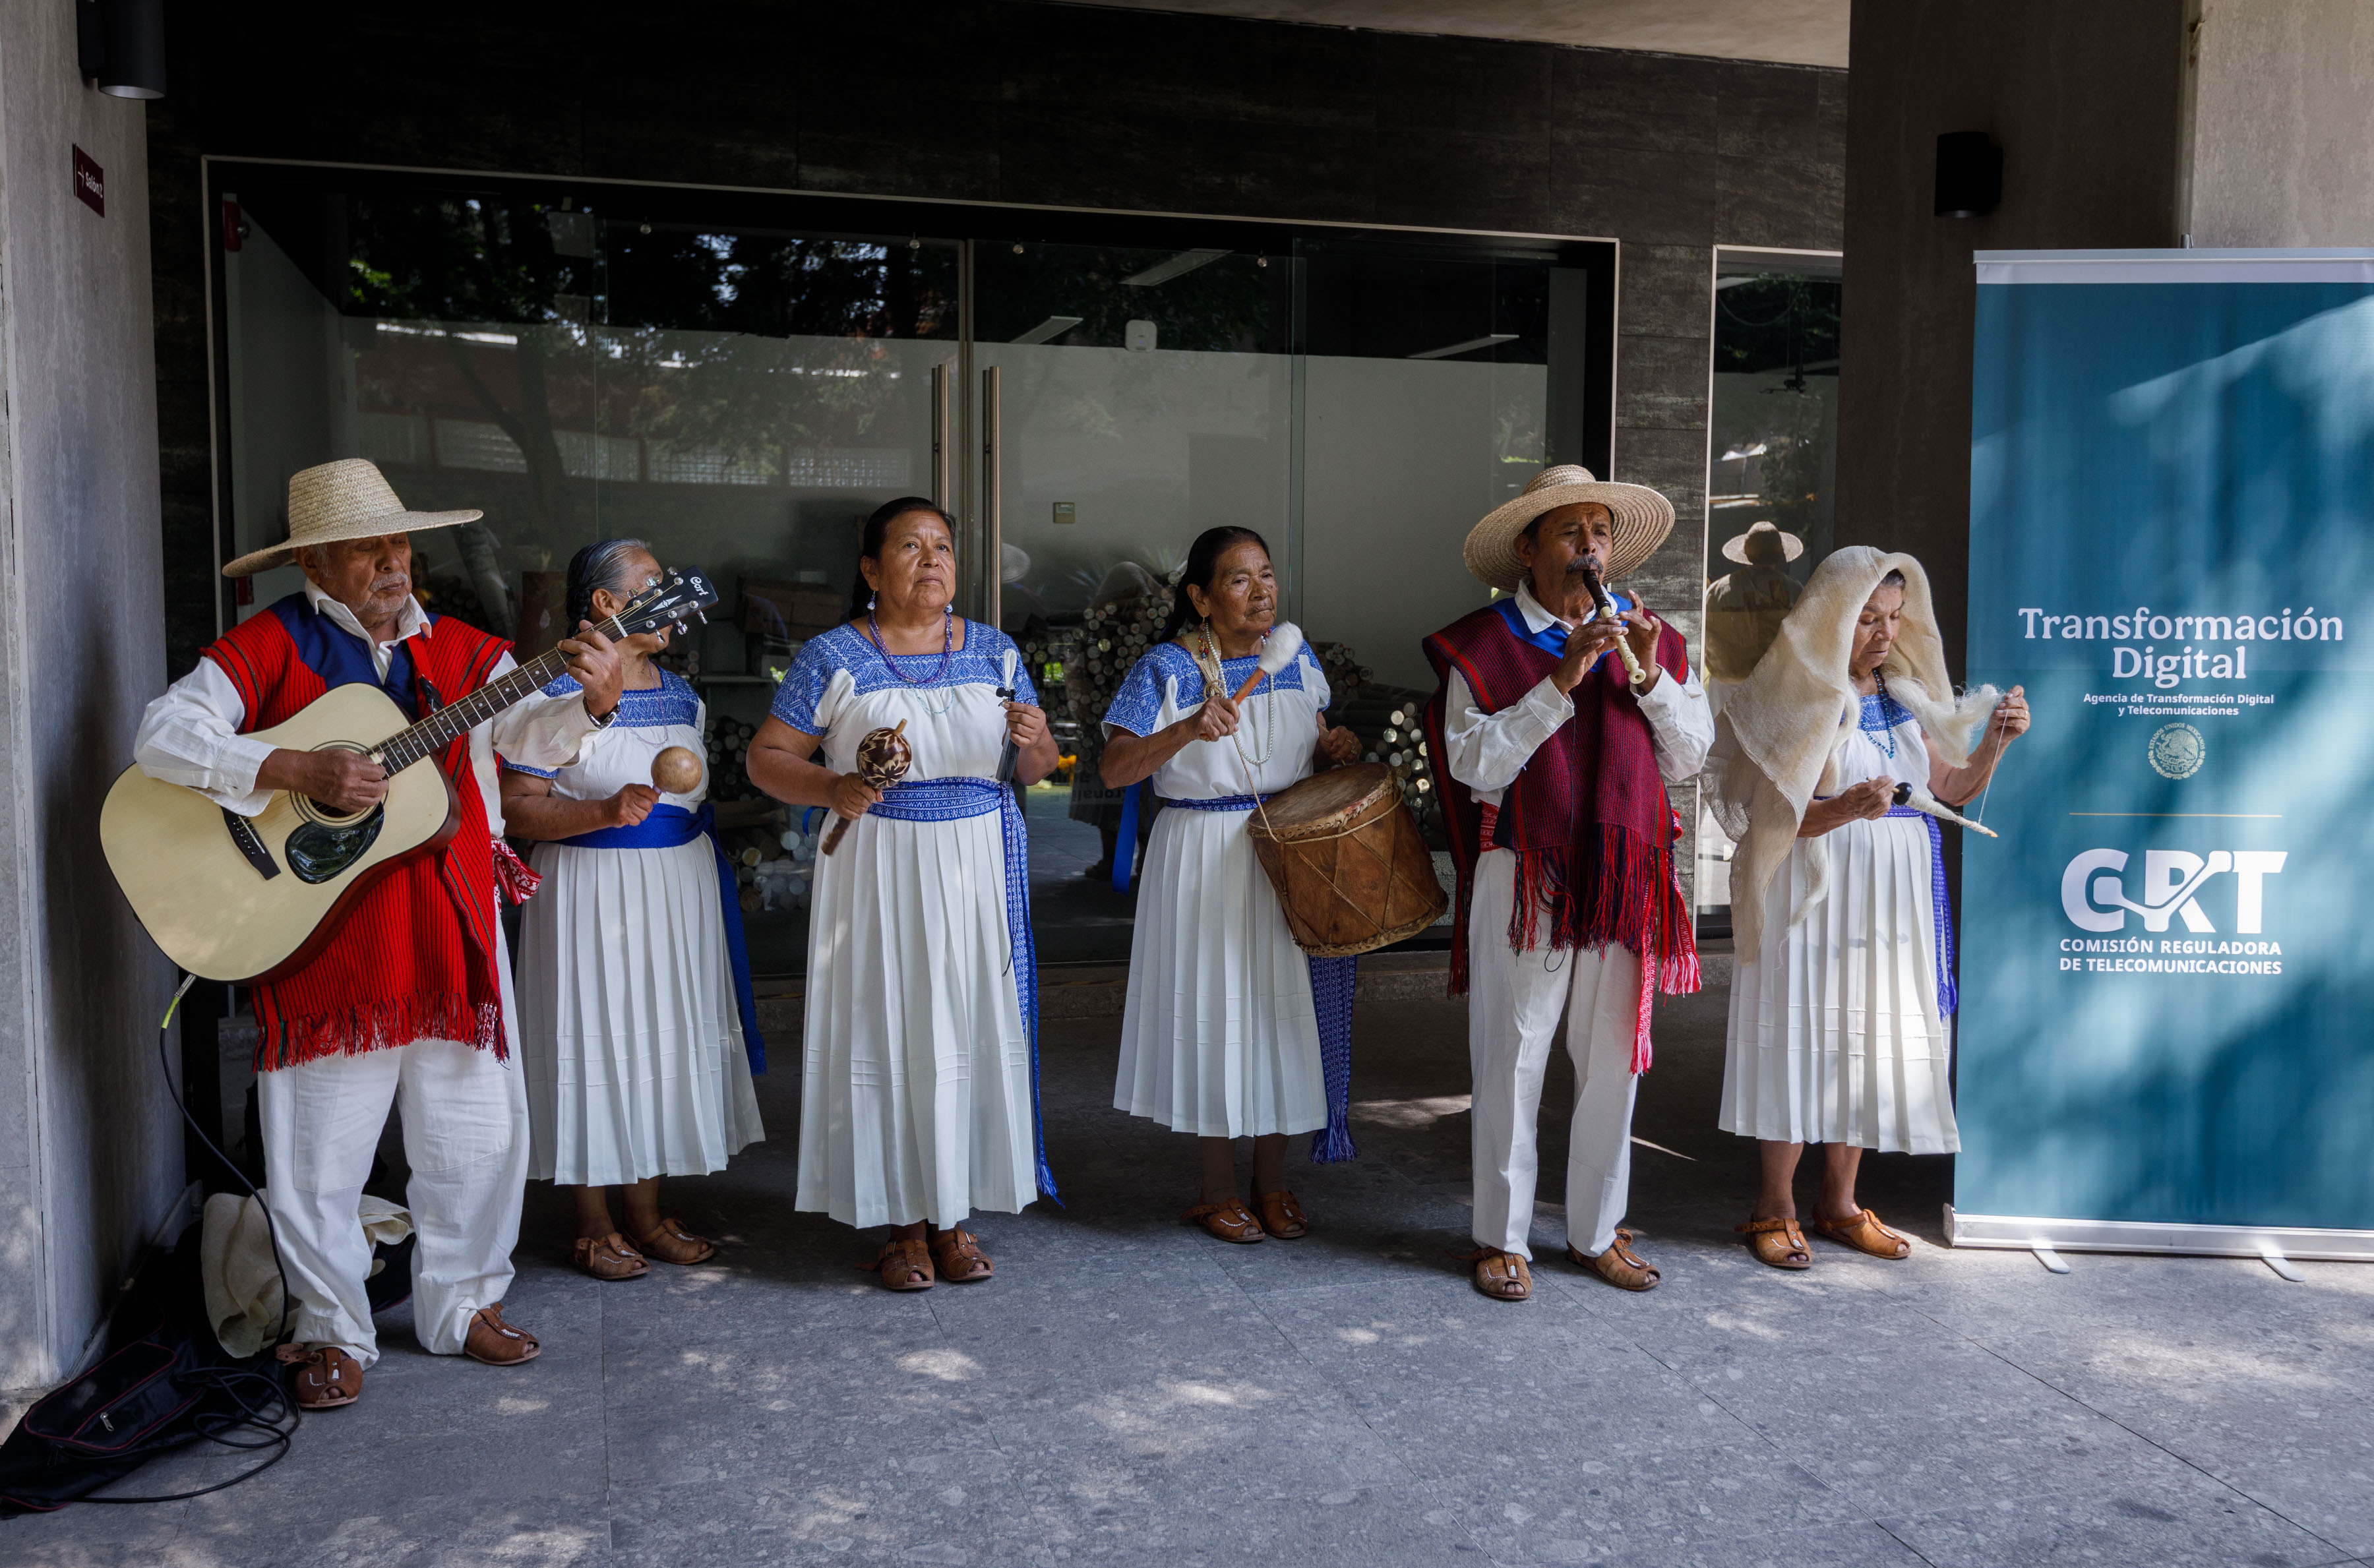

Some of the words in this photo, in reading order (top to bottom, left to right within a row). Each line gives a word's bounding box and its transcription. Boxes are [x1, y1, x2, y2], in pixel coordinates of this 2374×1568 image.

[85, 171, 100, 196] Salón
[690, 576, 710, 596] Cort
[2018, 606, 2344, 641] Transformación
[2112, 645, 2247, 689] Digital
[2083, 693, 2128, 705] Agencia
[2130, 693, 2144, 703] de
[2146, 694, 2234, 704] Transformación
[2237, 694, 2274, 706] Digital
[2117, 708, 2125, 717] y
[2127, 705, 2239, 715] Telecomunicaciones
[2148, 728, 2164, 749] ESTADOS
[2164, 722, 2185, 731] UNIDOS
[2186, 724, 2206, 750] MEXICANOS
[2061, 848, 2288, 934] CRT
[2059, 936, 2153, 953] COMISIÓN
[2160, 940, 2282, 955] REGULADORA
[2059, 957, 2081, 971] DE
[2086, 958, 2282, 975] TELECOMUNICACIONES
